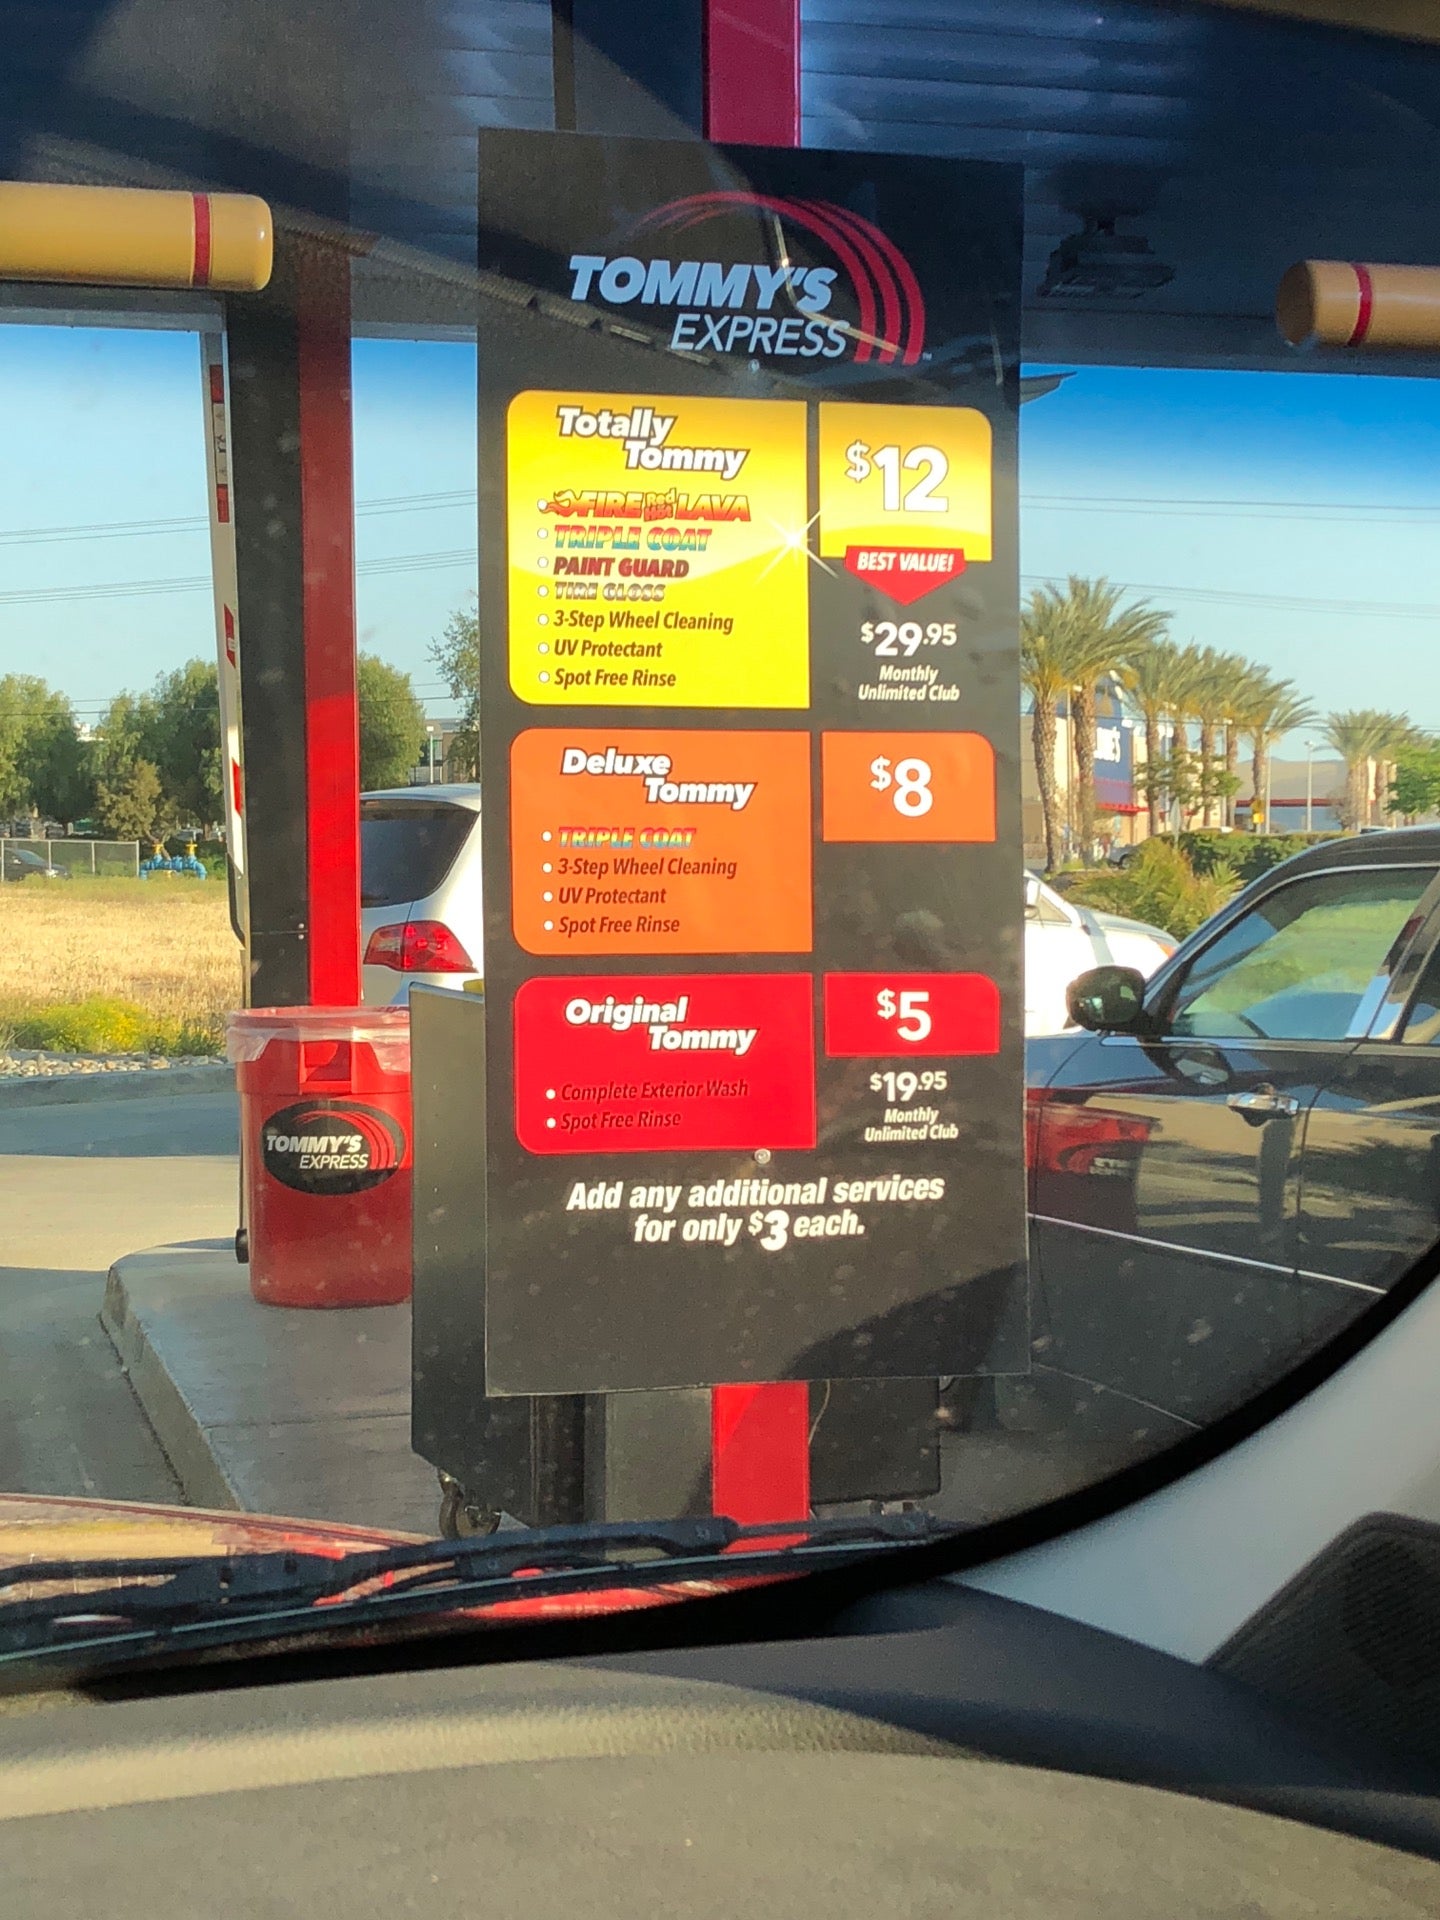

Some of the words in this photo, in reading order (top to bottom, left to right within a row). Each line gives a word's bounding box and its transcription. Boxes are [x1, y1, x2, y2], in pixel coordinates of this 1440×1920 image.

[569, 254, 838, 311] TOMMY'S
[670, 313, 849, 358] EXPRESS
[557, 406, 678, 446] Totally
[625, 439, 750, 480] Tommy
[845, 440, 949, 512] $12
[675, 493, 751, 522] LAVA
[554, 525, 642, 550] TRIPLE
[647, 527, 712, 551] COAT
[553, 556, 615, 576] PAINT
[618, 558, 690, 578] GUARD
[857, 551, 896, 571] BEST
[900, 553, 953, 572] VALUE!
[554, 581, 598, 600] TIRE
[602, 583, 666, 602] GLOSS
[553, 610, 605, 632] 3-Step
[609, 611, 660, 629] Wheel
[663, 611, 734, 635] Cleaning
[554, 639, 578, 656] UV
[581, 640, 662, 658] Protectant
[861, 622, 957, 657] $29.95
[554, 668, 591, 690] Spot
[595, 669, 628, 685] Free
[632, 668, 676, 687] Rinse
[879, 664, 939, 683] Monthly
[858, 684, 926, 701] Unlimited
[929, 684, 960, 701] Club
[560, 746, 673, 775] Deluxe
[643, 776, 758, 811] Tommy
[869, 755, 933, 818] $8
[558, 826, 635, 848] TRIPLE
[639, 827, 697, 848] COAT
[557, 858, 609, 879] 3-Step
[613, 858, 664, 875] Wheel
[667, 858, 737, 879] Cleaning
[558, 887, 583, 903] UV
[585, 888, 666, 904] Protectant
[558, 917, 596, 937] Spot
[600, 917, 632, 933] Free
[636, 916, 680, 933] Rinse
[564, 994, 690, 1031] Original
[875, 988, 933, 1042] $5
[649, 1025, 758, 1056] Tommy
[561, 1081, 638, 1104] Complete
[641, 1080, 703, 1099] Exterior
[706, 1078, 749, 1097] Wash
[869, 1070, 948, 1102] $19.95
[561, 1113, 597, 1134] Spot
[601, 1111, 634, 1128] Free
[638, 1110, 682, 1128] Rinse
[884, 1106, 940, 1125] Monthly
[266, 1135, 363, 1153] TOMMY'S
[864, 1124, 929, 1142] Unlimited
[929, 1123, 959, 1140] Club
[300, 1154, 369, 1169] EXPRESS
[567, 1182, 624, 1211] Add
[629, 1185, 683, 1213] any
[688, 1177, 829, 1208] additional
[832, 1174, 945, 1203] services
[634, 1214, 676, 1242] for
[681, 1212, 743, 1246] only
[748, 1209, 789, 1252] $3
[793, 1209, 866, 1237] each.
